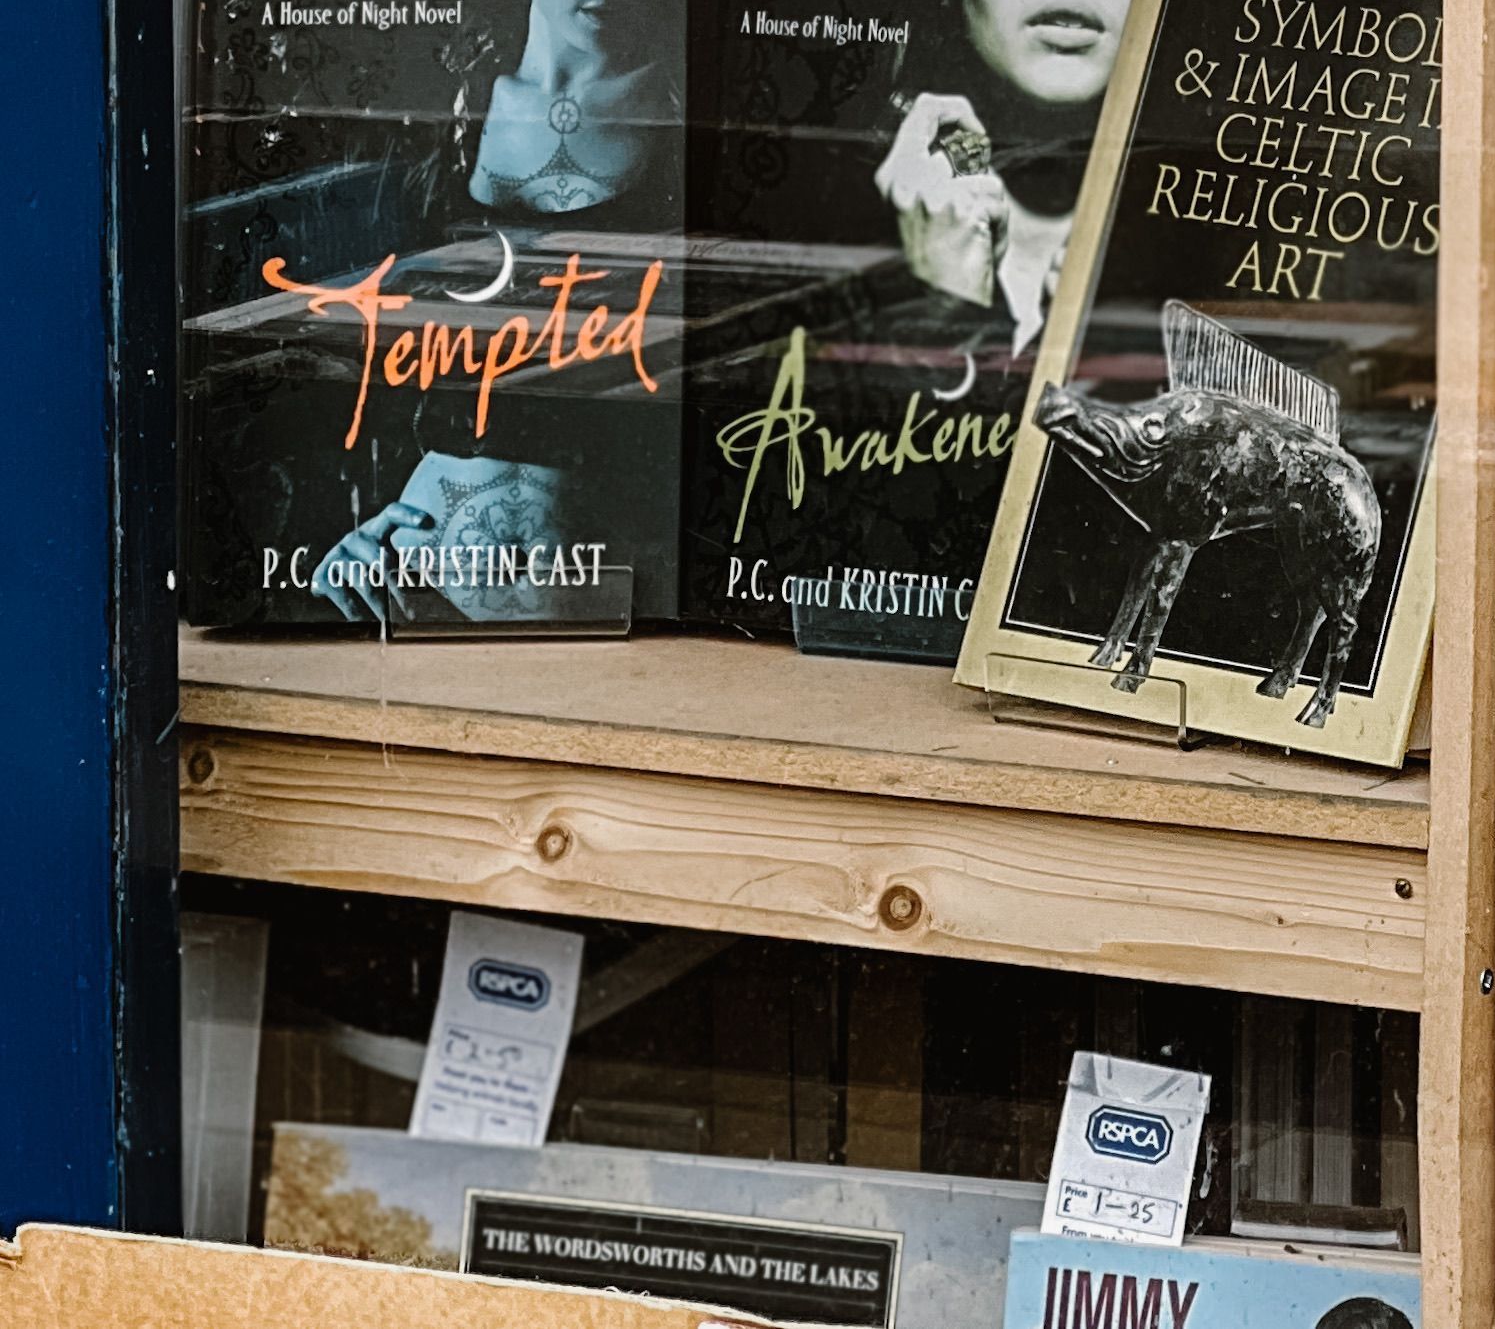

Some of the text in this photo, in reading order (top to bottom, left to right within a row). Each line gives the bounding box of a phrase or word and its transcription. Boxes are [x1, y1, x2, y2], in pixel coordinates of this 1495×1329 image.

[262, 1, 462, 29] A House of Night Novel
[1227, 53, 1408, 125] IMAGE
[1216, 112, 1412, 186] CELTIC
[1146, 164, 1439, 255] RELIGIOUS
[1226, 240, 1345, 301] ART
[261, 253, 664, 450] Tempted
[262, 543, 606, 590] P.C. and KRISTIN CAST
[1098, 1119, 1160, 1150] RSPCA
[482, 1228, 879, 1292] THE WORDSWORTHS AND THE LAKES
